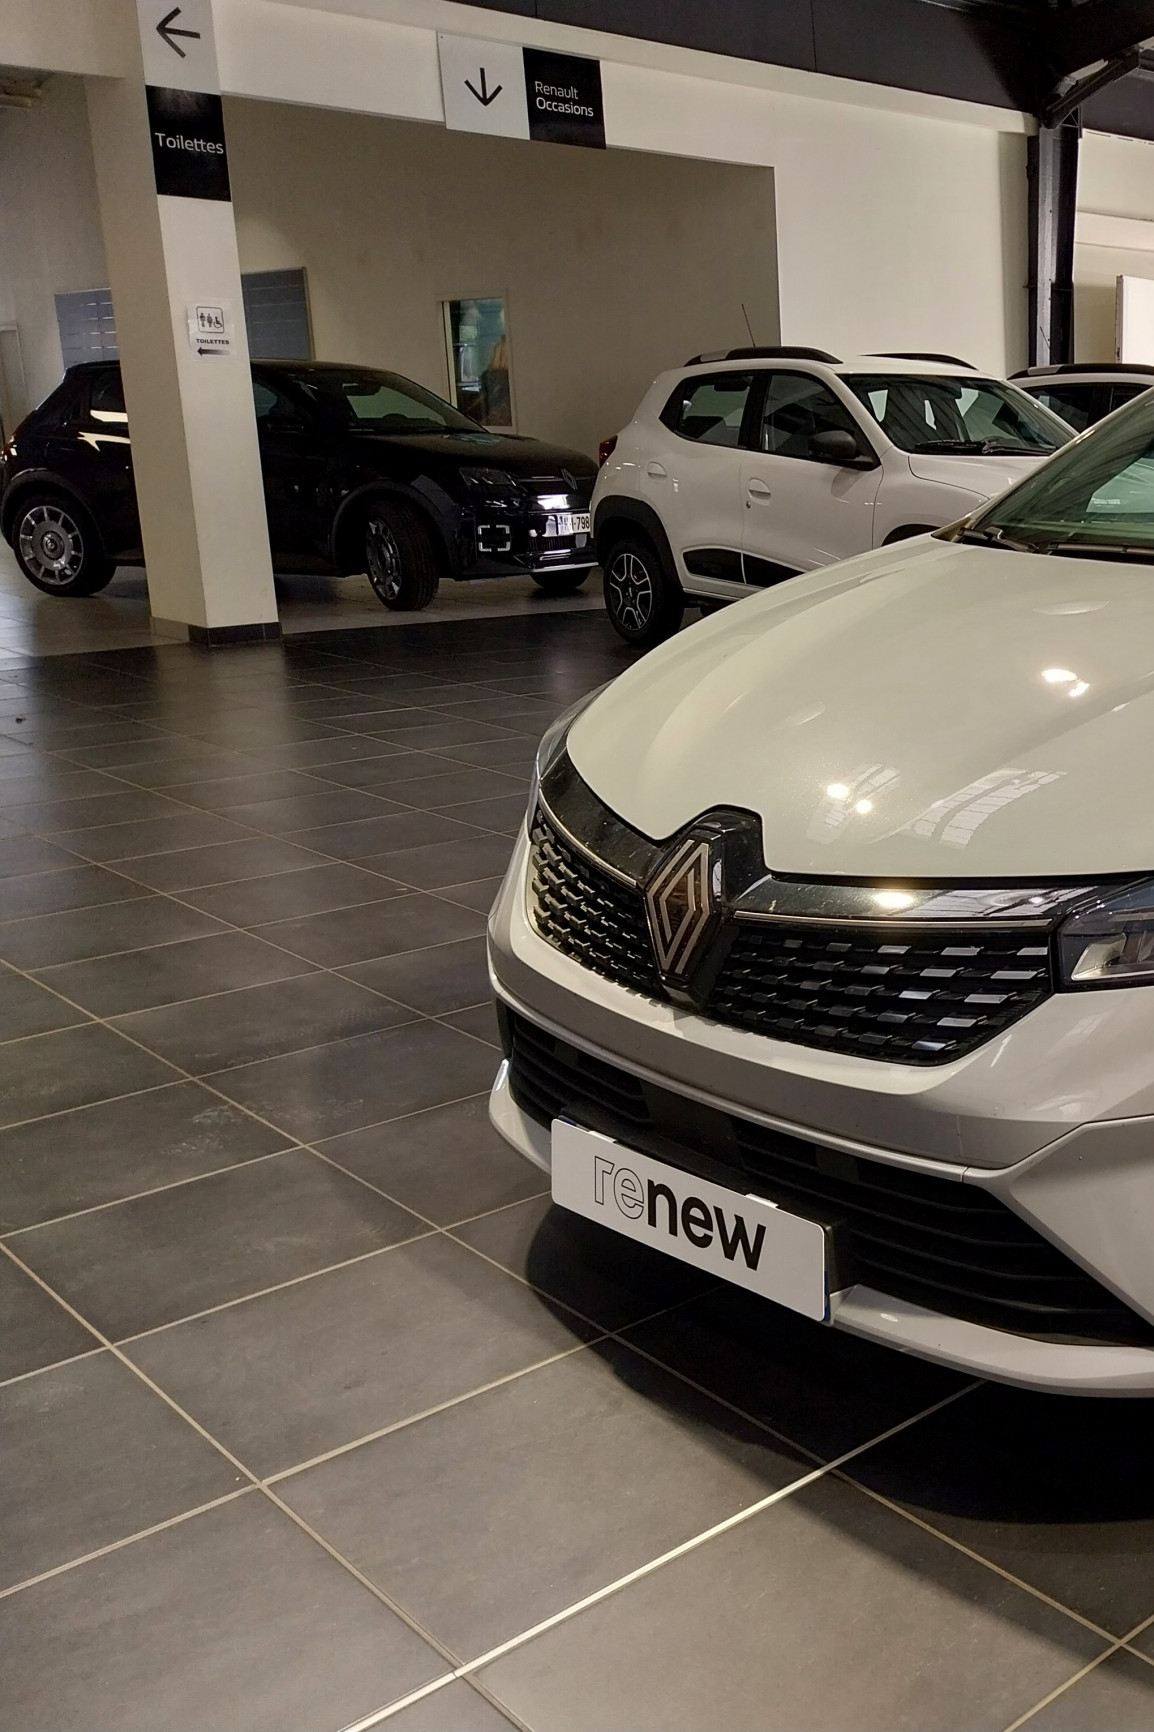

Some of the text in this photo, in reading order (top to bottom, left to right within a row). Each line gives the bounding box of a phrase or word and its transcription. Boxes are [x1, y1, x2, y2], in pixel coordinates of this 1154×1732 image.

[535, 81, 579, 99] Renault
[536, 97, 594, 117] Occasions
[154, 132, 224, 154] Toilettes
[595, 1155, 767, 1272] renew
